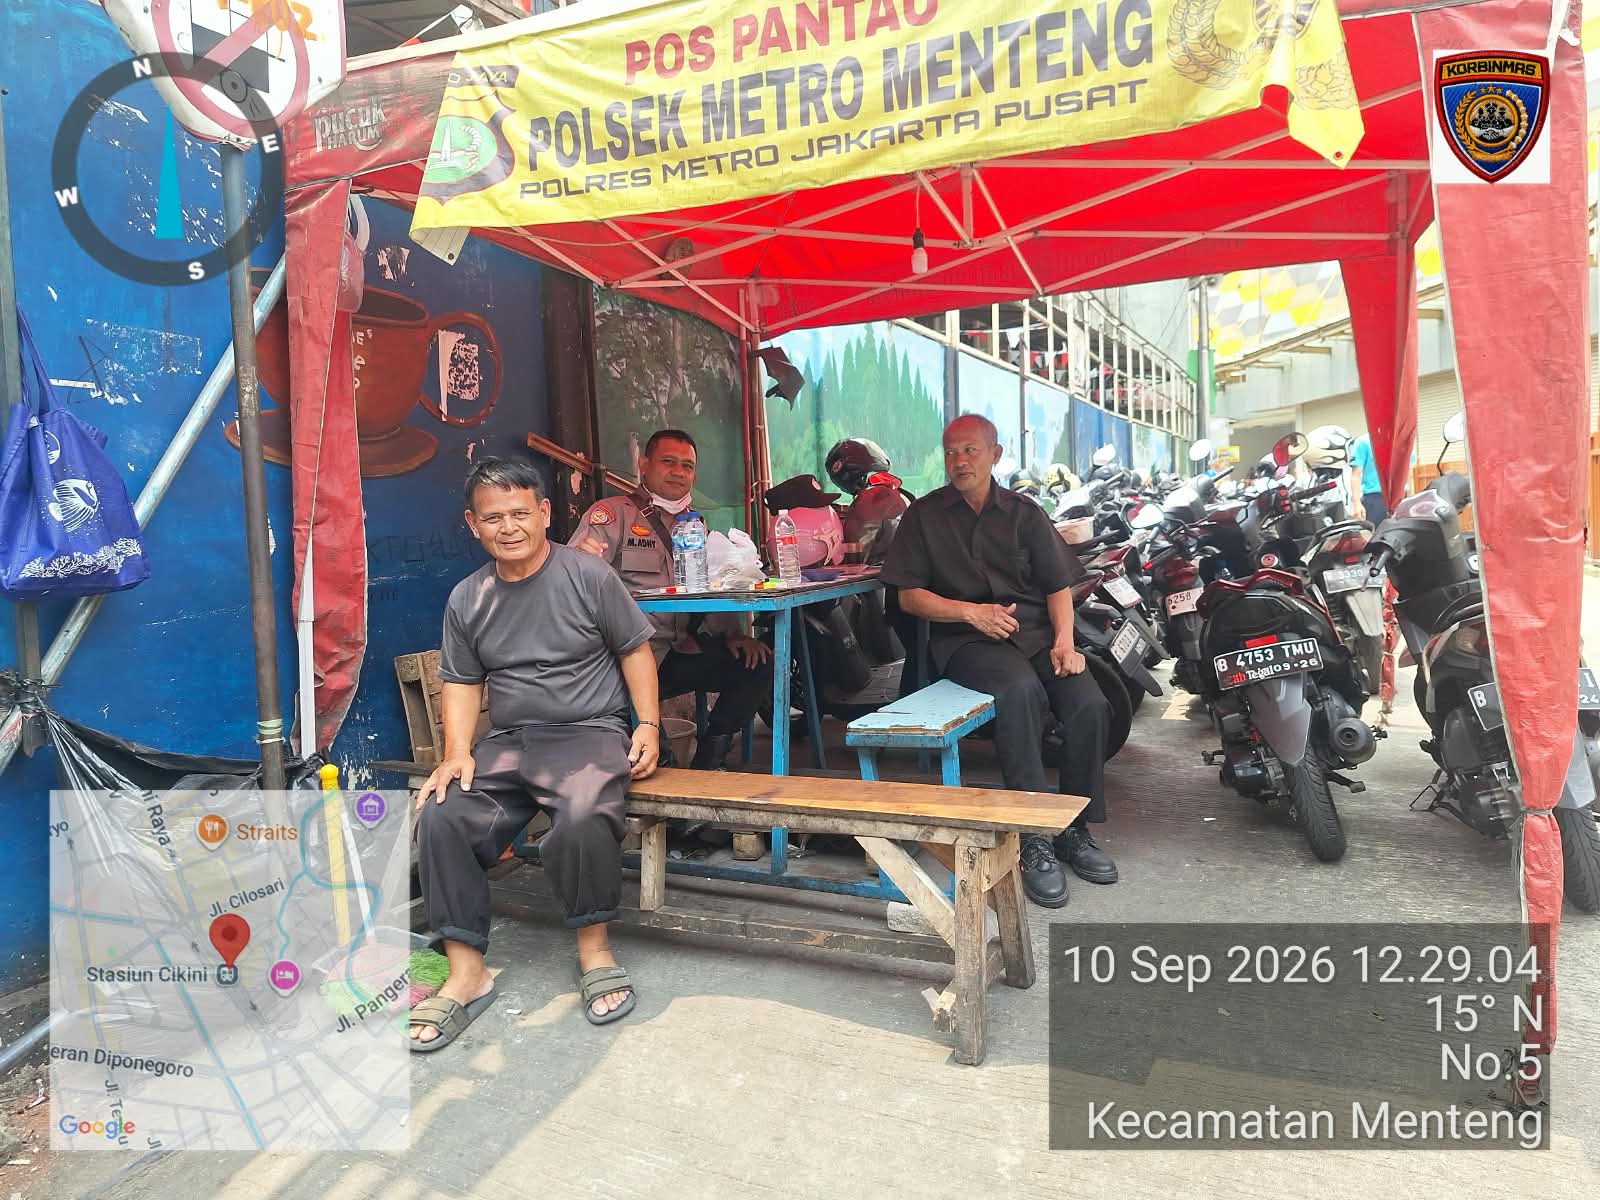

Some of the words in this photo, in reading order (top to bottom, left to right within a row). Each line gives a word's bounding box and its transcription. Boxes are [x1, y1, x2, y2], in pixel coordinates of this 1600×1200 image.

[529, 89, 689, 171] POLSEK
[703, 55, 863, 144] METRO
[883, 0, 1152, 113] MENTENG
[625, 25, 715, 85] POS
[520, 167, 651, 199] POLRES
[662, 144, 779, 179] METRO
[792, 110, 980, 161] JAKARTA
[994, 78, 1147, 127] PUSAT
[1216, 658, 1228, 672] B
[1236, 648, 1274, 667] 4753
[1281, 641, 1314, 657] TMU
